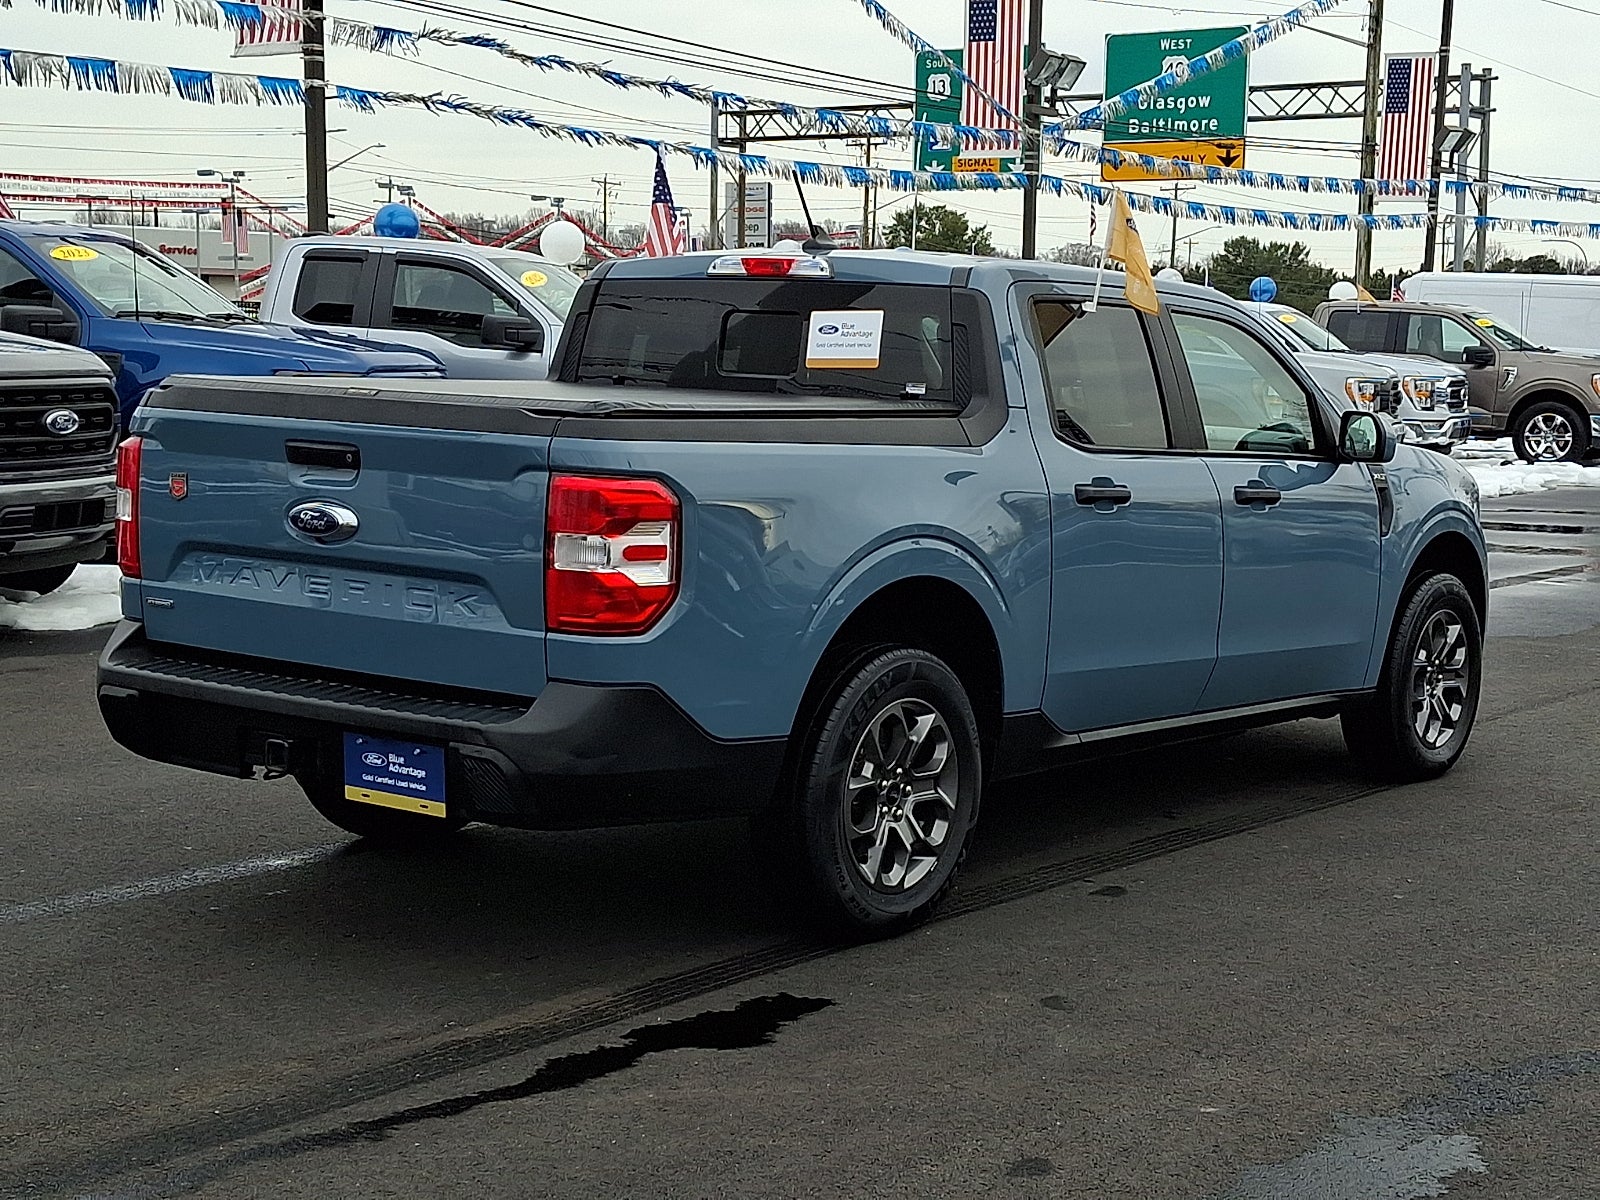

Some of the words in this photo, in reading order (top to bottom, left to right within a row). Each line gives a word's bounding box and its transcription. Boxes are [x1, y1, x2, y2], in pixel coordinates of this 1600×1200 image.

[1160, 38, 1193, 51] WEST
[932, 79, 946, 95] 13
[1138, 95, 1212, 113] Glasgow
[1128, 117, 1219, 134] Baltimore
[957, 158, 995, 168] SIGNAL
[159, 244, 198, 256] Service
[296, 510, 329, 530] Ford
[190, 560, 480, 618] MAVERICK
[388, 753, 405, 764] Blue
[388, 763, 426, 778] Advantage
